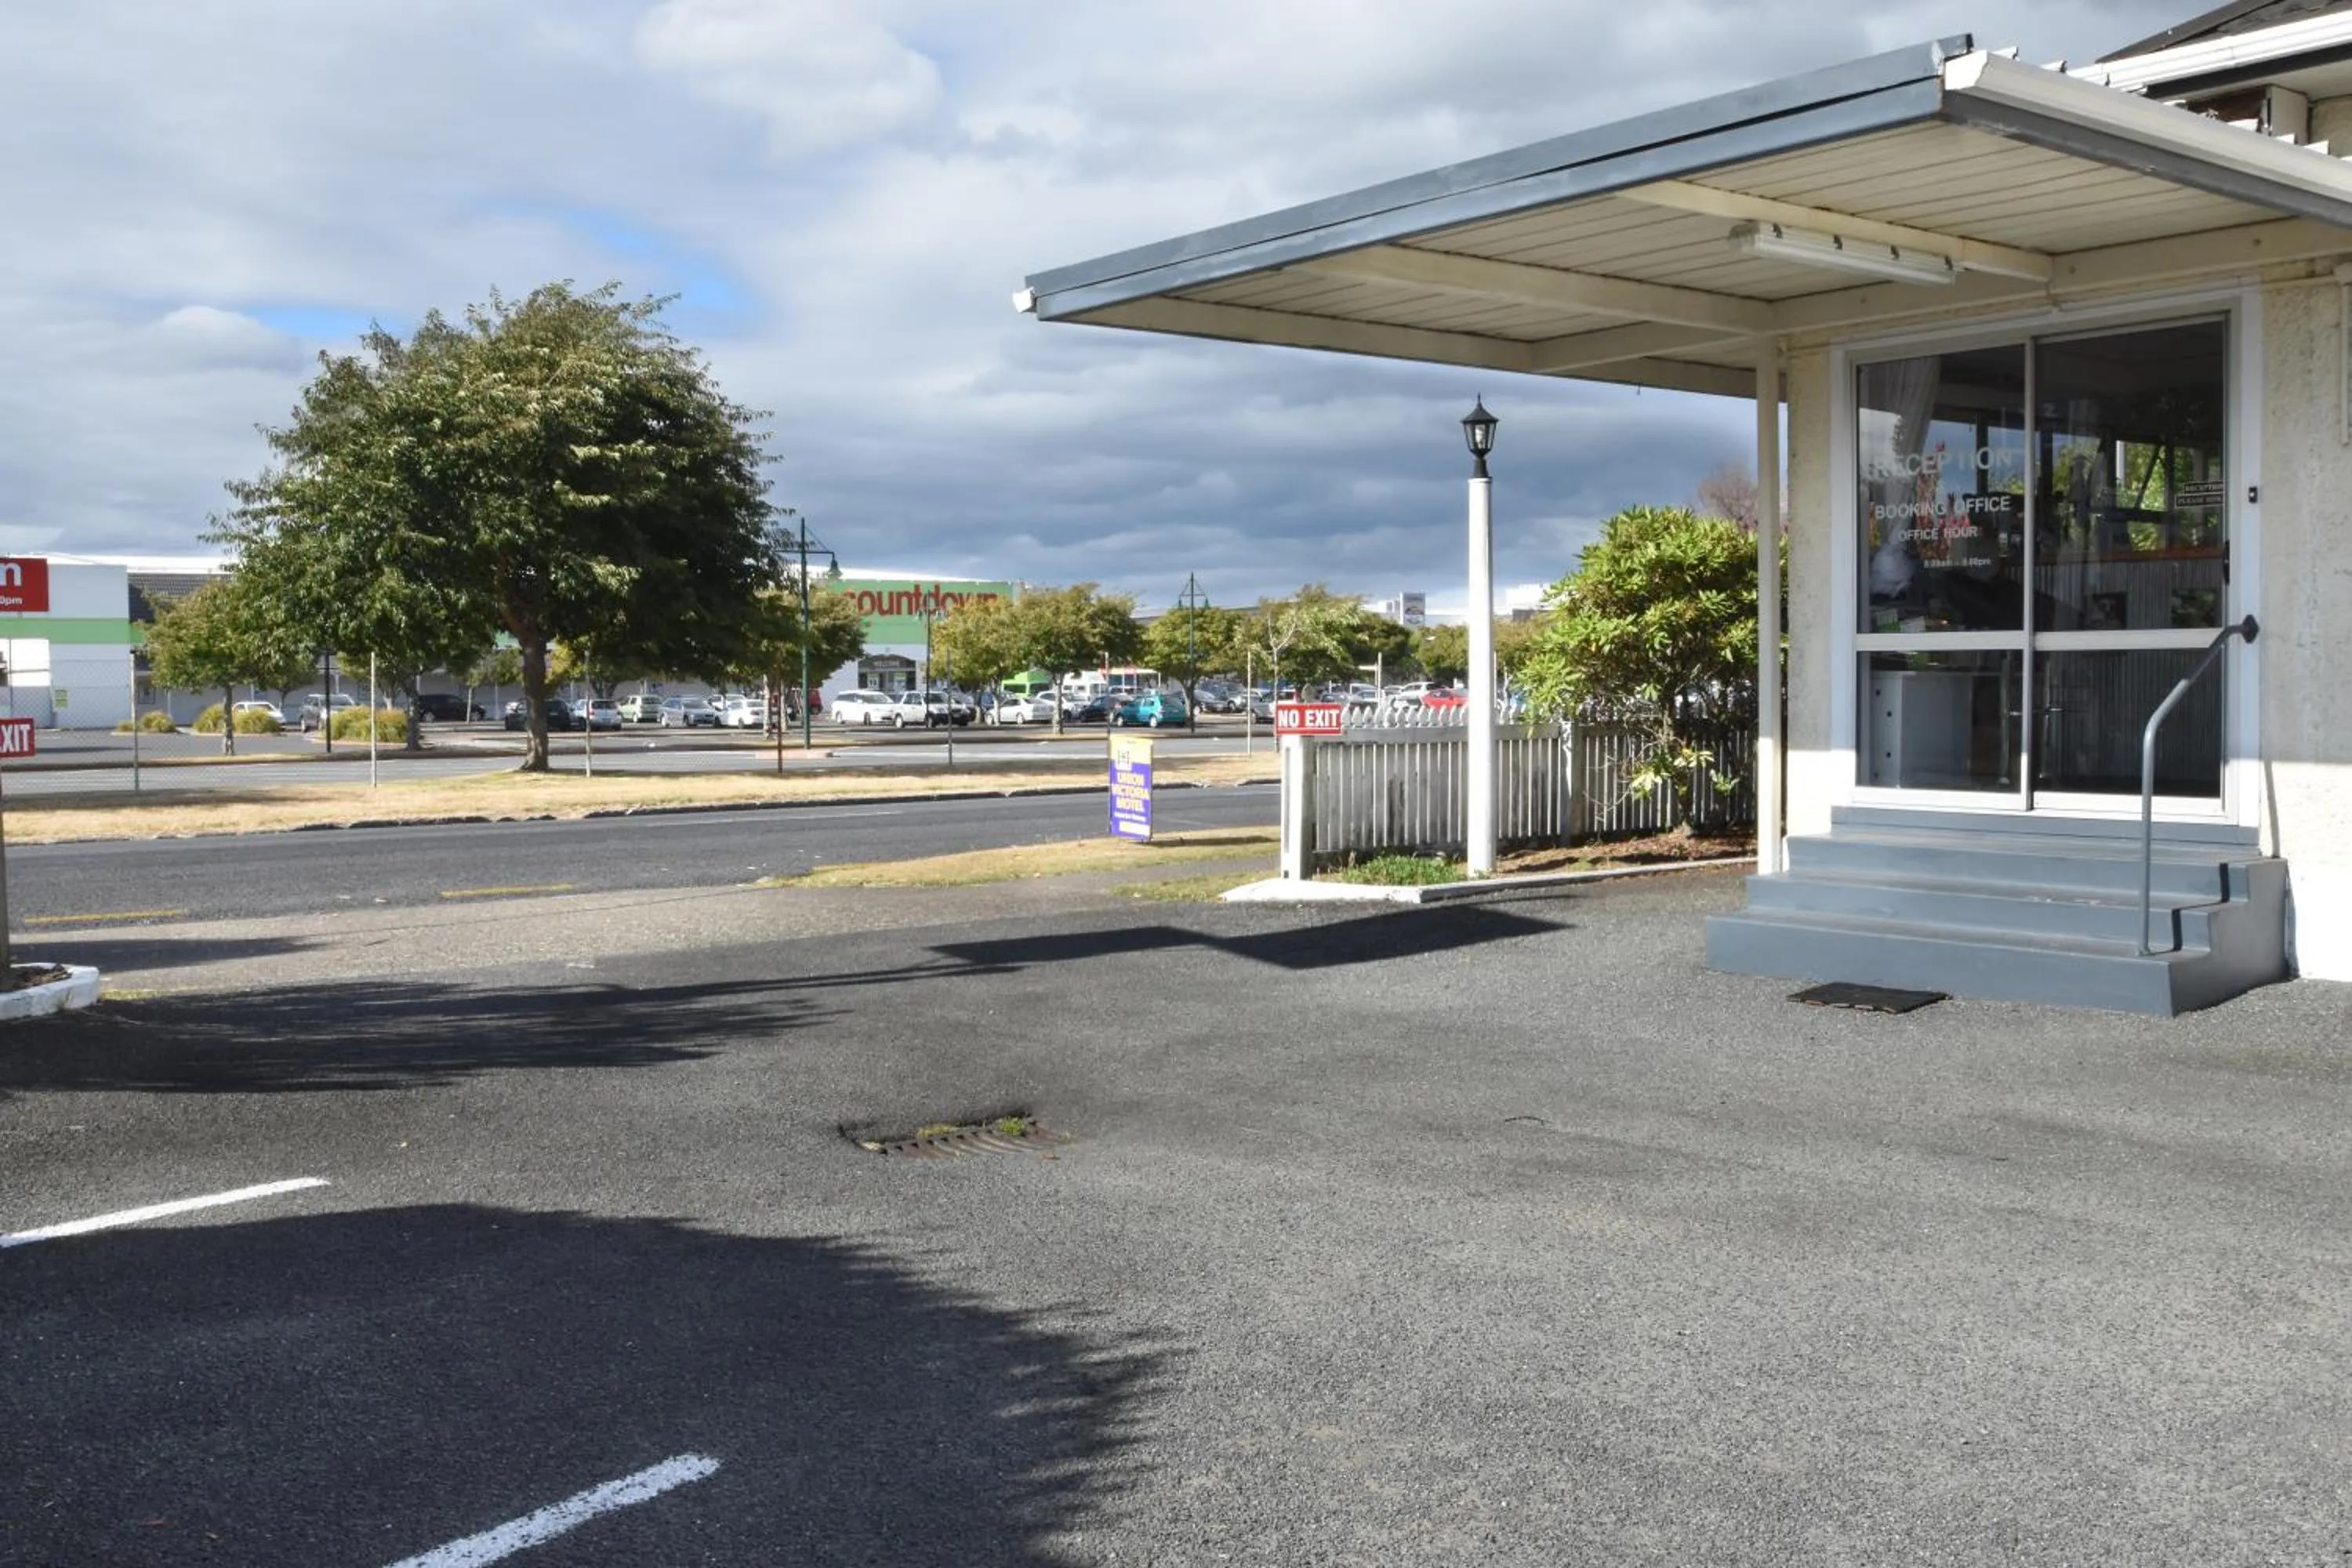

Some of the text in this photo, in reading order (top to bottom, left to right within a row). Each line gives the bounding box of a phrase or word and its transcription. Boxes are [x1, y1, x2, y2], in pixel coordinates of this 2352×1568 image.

[1876, 446, 2013, 477] RECEPTION
[1875, 495, 2012, 520] BOOKING OFFICE
[1898, 528, 1939, 542] OFFICE
[1278, 708, 1340, 728] NO EXIT
[0, 724, 31, 753] XIT
